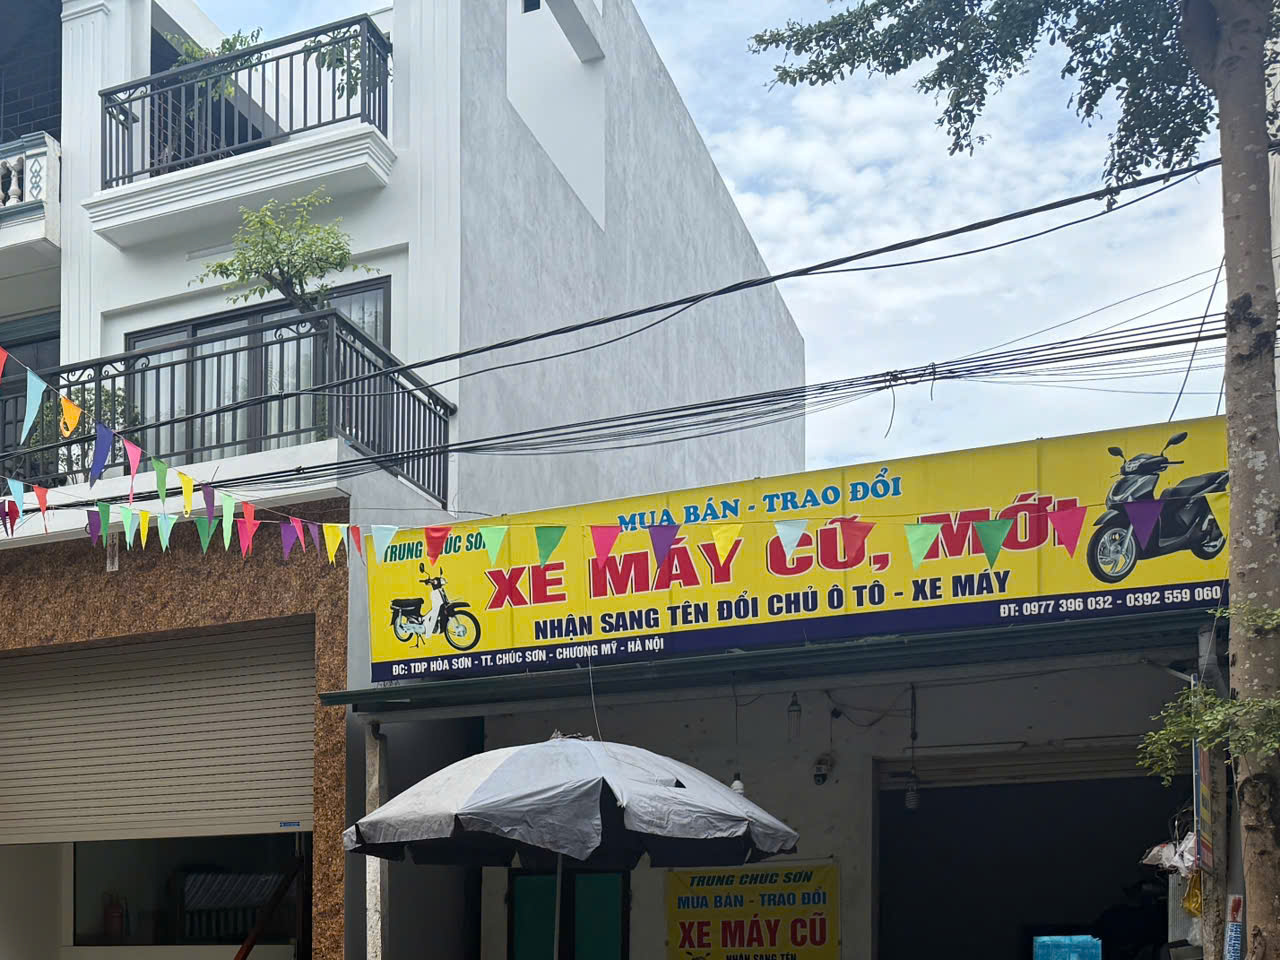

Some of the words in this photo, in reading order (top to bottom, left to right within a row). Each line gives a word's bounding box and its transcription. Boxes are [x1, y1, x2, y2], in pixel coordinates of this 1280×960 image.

[617, 509, 676, 533] MUA
[684, 496, 741, 525] BÁN
[763, 484, 841, 513] TRAO
[849, 467, 903, 502] ĐỔI
[485, 562, 567, 611] XE
[590, 536, 742, 600] MÁY
[767, 513, 891, 577] CŨ,
[535, 613, 593, 640] NHẬN
[601, 609, 659, 634] SANG
[667, 600, 708, 627] TÊN
[717, 585, 759, 620] ĐỔI
[768, 585, 818, 616] CHỦ
[827, 584, 843, 610] Ô
[852, 579, 886, 607] TÔ
[912, 577, 942, 601] XE
[952, 568, 1011, 596] MÁY
[1000, 603, 1019, 617] ĐT:
[1022, 600, 1053, 616] 0977
[1059, 598, 1083, 613] 396
[1087, 596, 1113, 610] 032
[1126, 592, 1160, 608] 0392
[1164, 589, 1191, 604] 559
[1194, 586, 1221, 601] 060
[392, 663, 408, 675] ĐC:
[410, 661, 428, 673] TDP
[430, 657, 449, 671] HÒA
[451, 657, 472, 669] SƠN
[481, 656, 494, 667] TT.
[496, 651, 523, 665] CHÚC
[525, 649, 547, 662] SƠN
[556, 644, 598, 660] CHƯƠNG
[601, 641, 617, 657] MỸ
[627, 638, 642, 653] HÀ
[645, 636, 664, 652] NỘI
[689, 874, 735, 888] TRUNG
[677, 895, 709, 910] MUA
[759, 893, 796, 907] TRAO
[679, 920, 712, 949] XE
[721, 913, 781, 948] MÁY
[790, 912, 827, 947] CŨ
